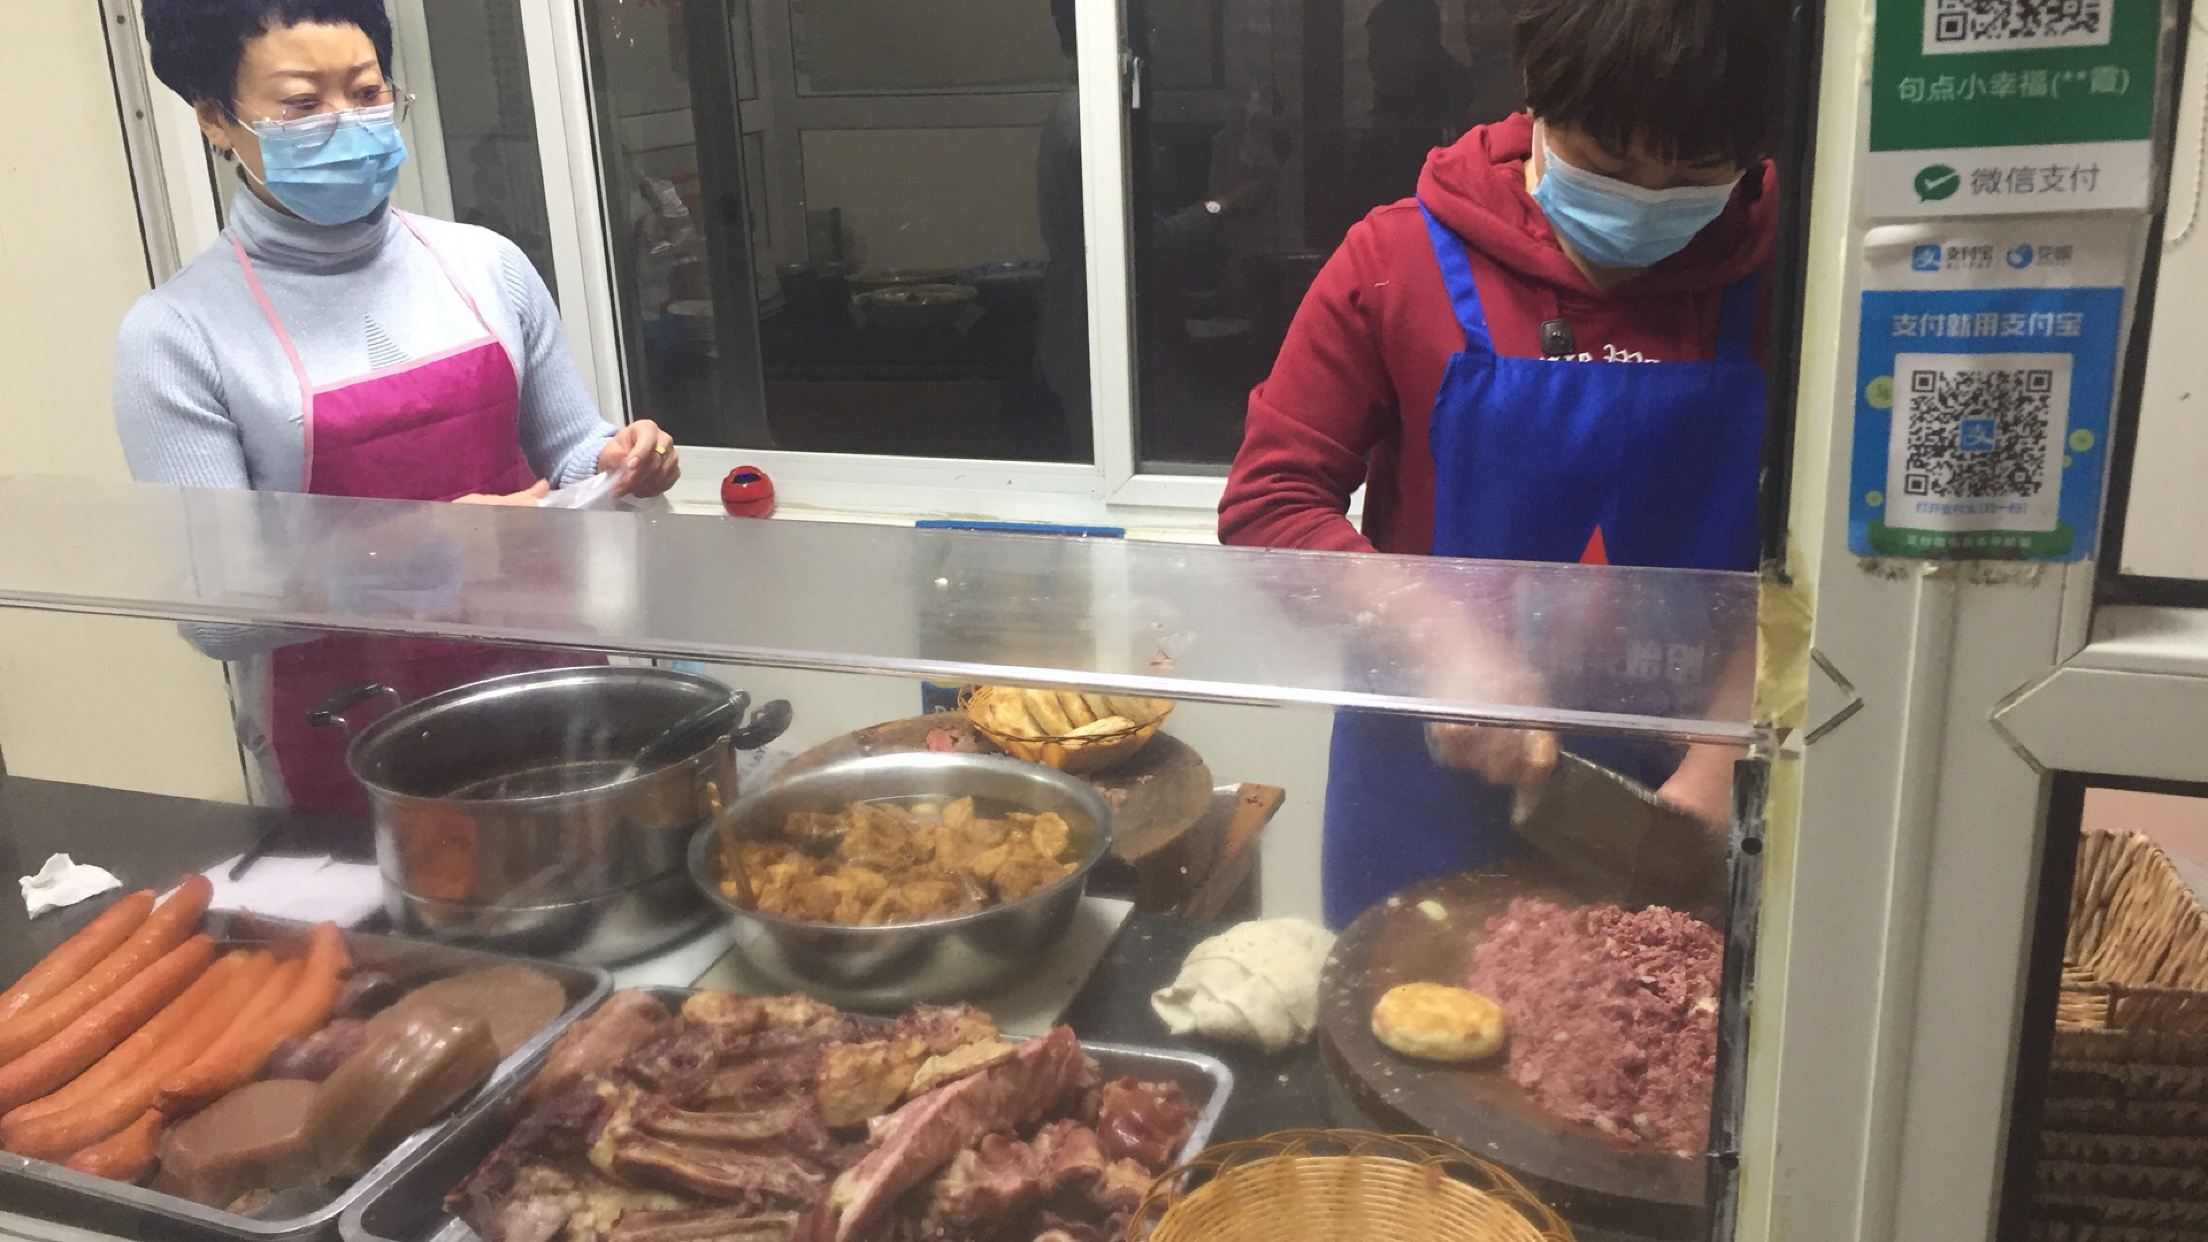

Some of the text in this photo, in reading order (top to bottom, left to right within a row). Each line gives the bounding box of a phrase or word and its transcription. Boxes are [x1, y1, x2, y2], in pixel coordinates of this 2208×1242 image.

[1970, 163, 2100, 195] 微信支付
[1892, 312, 2083, 337] 支付就用支付宝
